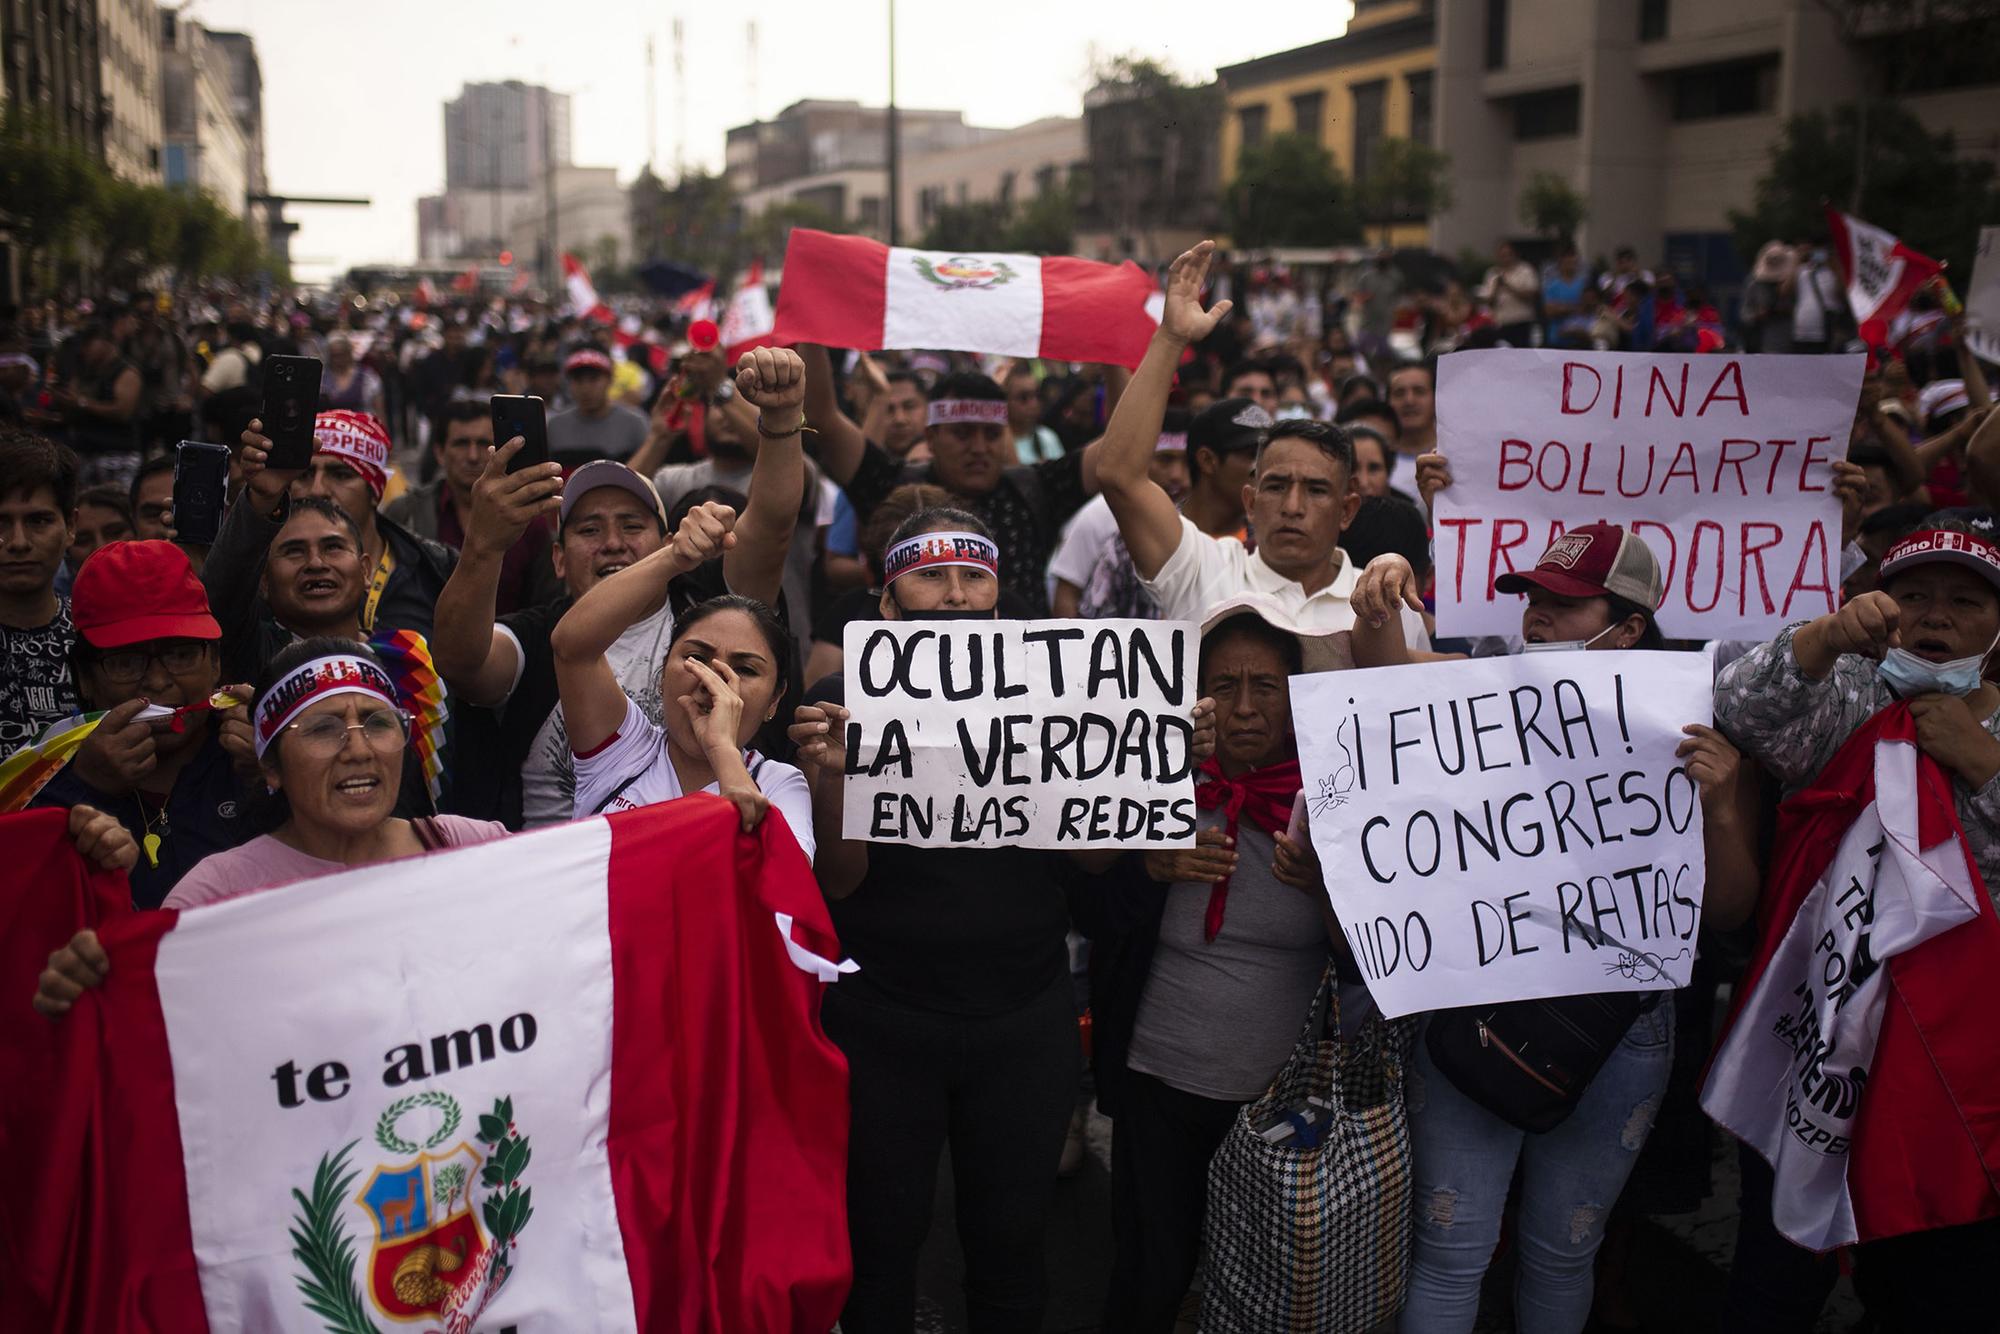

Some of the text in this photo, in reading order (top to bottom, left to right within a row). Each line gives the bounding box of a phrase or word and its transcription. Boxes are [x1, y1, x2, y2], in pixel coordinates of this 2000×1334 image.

[1561, 361, 1749, 418] DINA
[1498, 435, 1832, 498] BOLUARTE
[1440, 517, 1837, 617] TRDORA
[1970, 541, 2000, 571] Pe
[859, 628, 1185, 706] OCULTAN
[845, 709, 1192, 788] LA VERDAD
[870, 792, 1196, 843] EN LAS REDES
[1361, 766, 1697, 884] CONGRESO
[1344, 863, 1702, 980] NIDO DE RATAS
[270, 1011, 537, 1109] te amo
